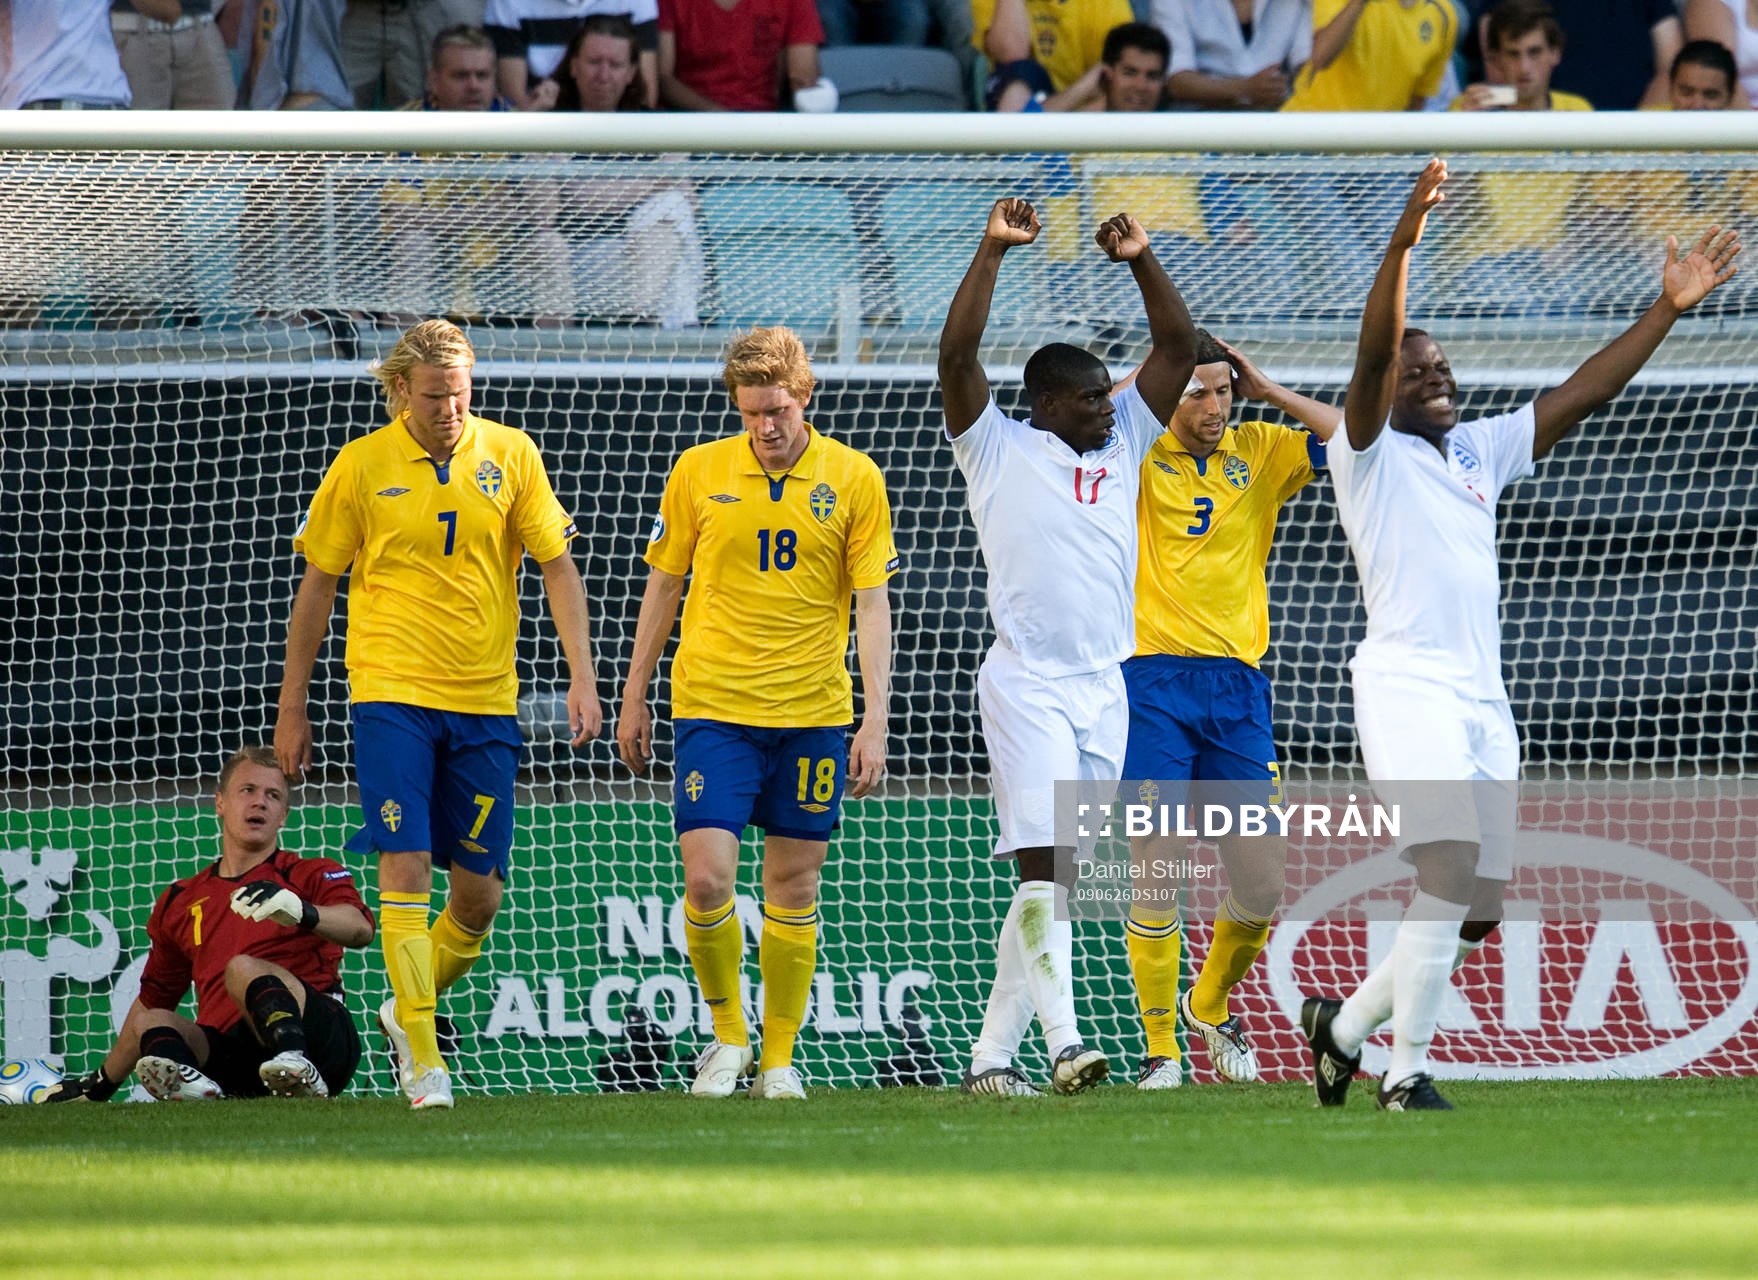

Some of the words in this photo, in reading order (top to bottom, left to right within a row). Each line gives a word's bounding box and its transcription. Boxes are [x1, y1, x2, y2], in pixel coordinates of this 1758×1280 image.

[1075, 467, 1107, 504] 17
[438, 511, 457, 556] 7
[1187, 497, 1214, 536] 3
[757, 529, 797, 571] 18
[797, 757, 835, 803] 18
[469, 795, 495, 839] 7
[191, 904, 203, 946] 1
